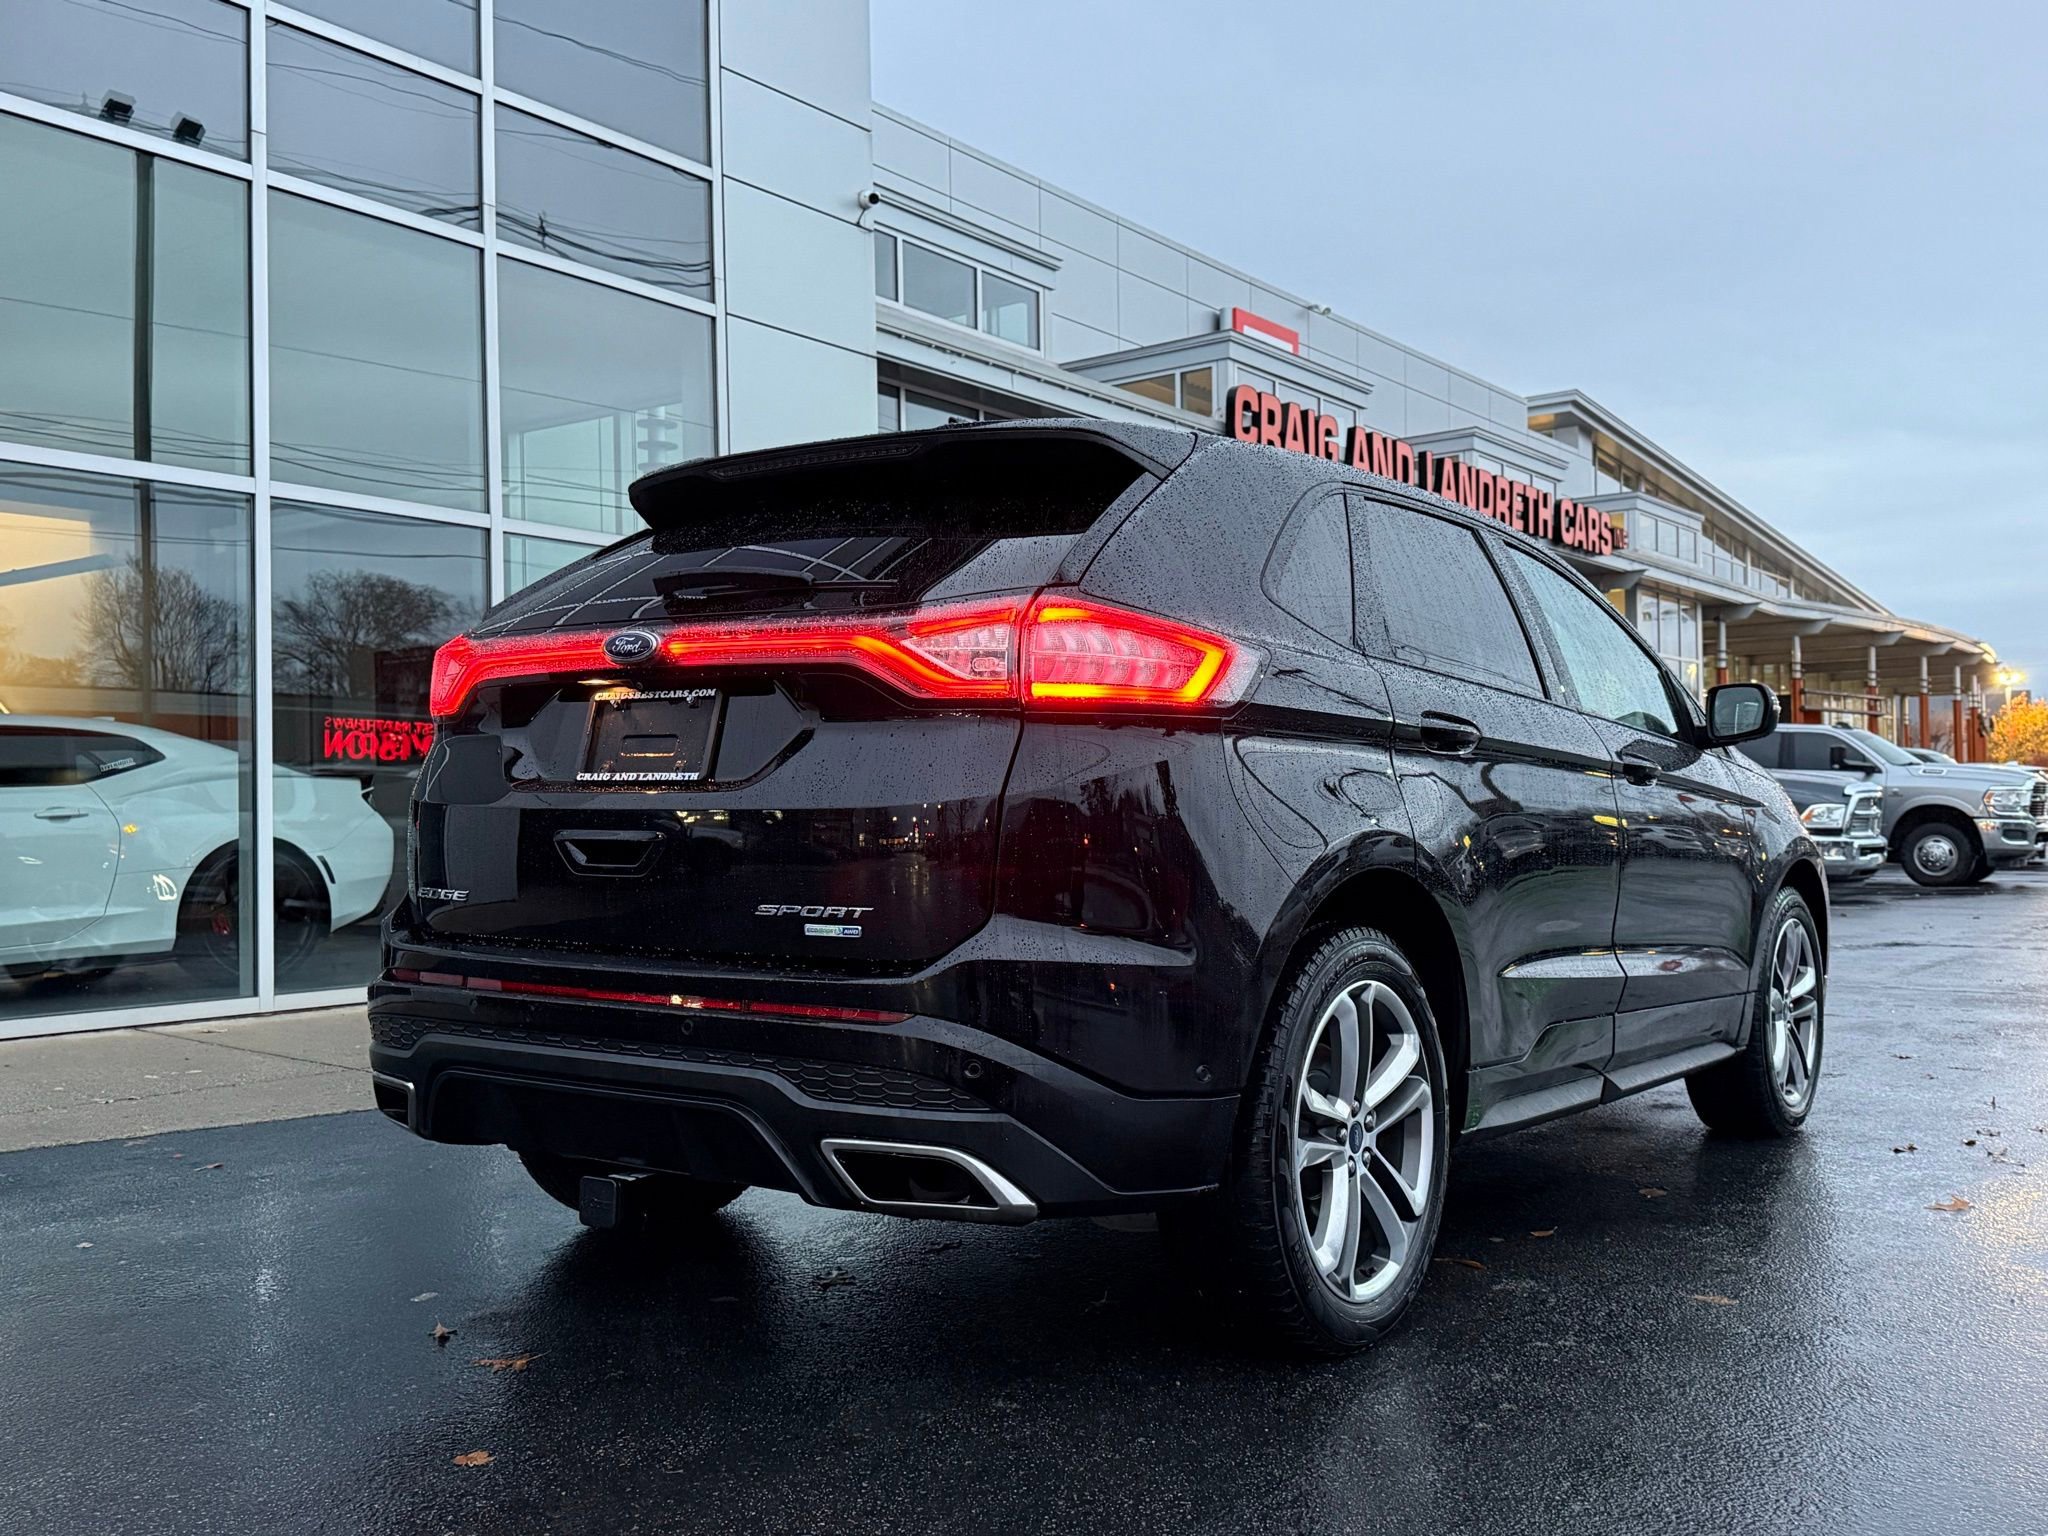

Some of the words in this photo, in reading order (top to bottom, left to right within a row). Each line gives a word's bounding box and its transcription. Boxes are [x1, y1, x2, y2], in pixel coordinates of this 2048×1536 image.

[1232, 383, 1339, 464] CRAIG
[1351, 425, 1415, 487] AND
[1424, 450, 1554, 540] LANDRETH
[1560, 497, 1613, 556] CARS
[612, 636, 642, 654] Ford
[576, 771, 611, 781] CRAIG
[612, 771, 637, 781] AND
[638, 771, 700, 781] LANDRETH
[417, 886, 469, 901] EDGE
[755, 904, 874, 918] SPORT
